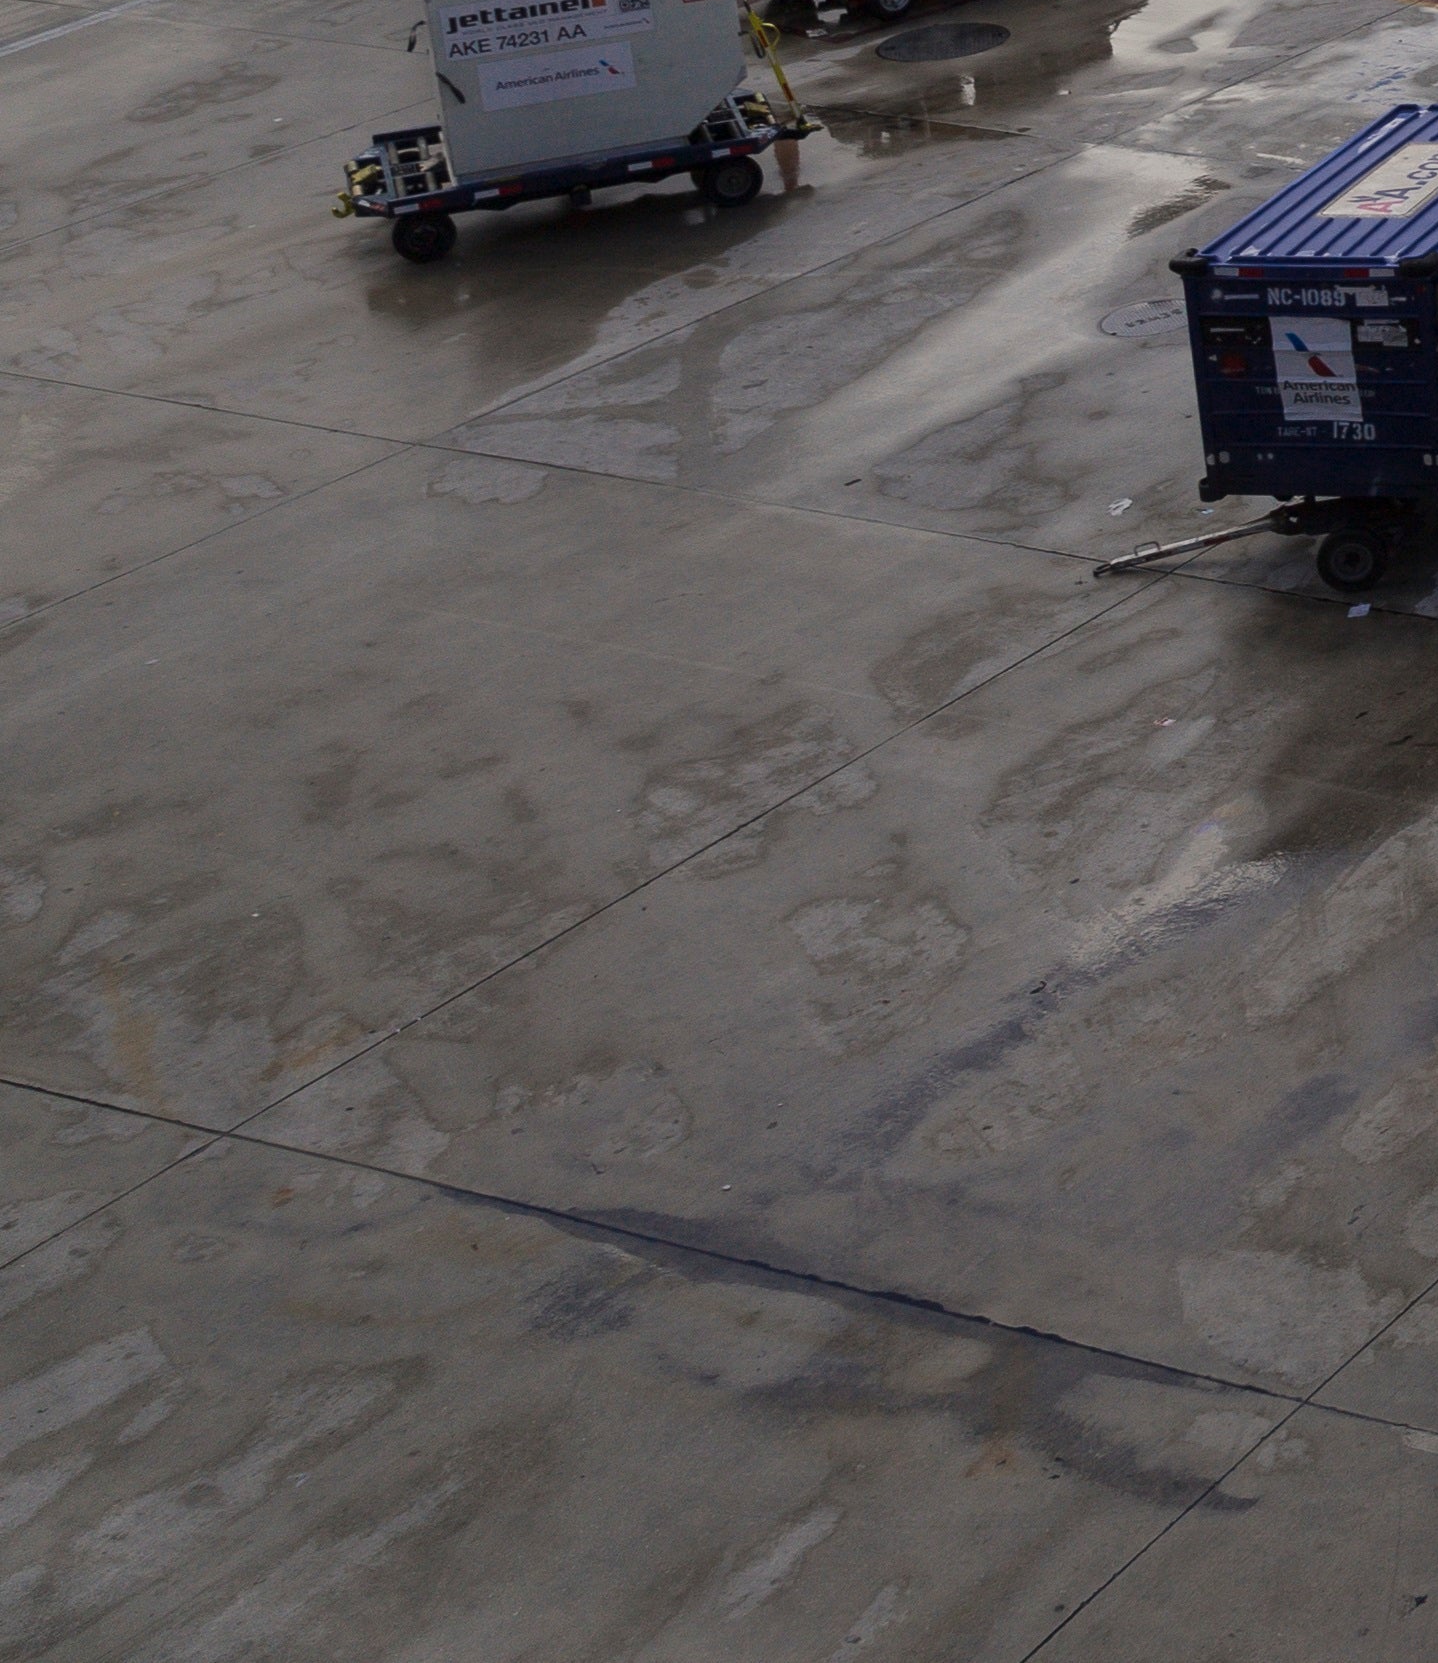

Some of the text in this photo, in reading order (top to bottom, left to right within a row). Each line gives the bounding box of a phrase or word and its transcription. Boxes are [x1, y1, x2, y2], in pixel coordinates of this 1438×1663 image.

[449, 38, 492, 58] AKE
[496, 30, 551, 51] 74231
[557, 23, 587, 41] AA
[496, 66, 600, 91] American Airlines
[1266, 287, 1347, 306] NC-1089
[1284, 380, 1356, 392] American
[1293, 391, 1351, 405] Airlines
[1332, 421, 1376, 441] 1730
